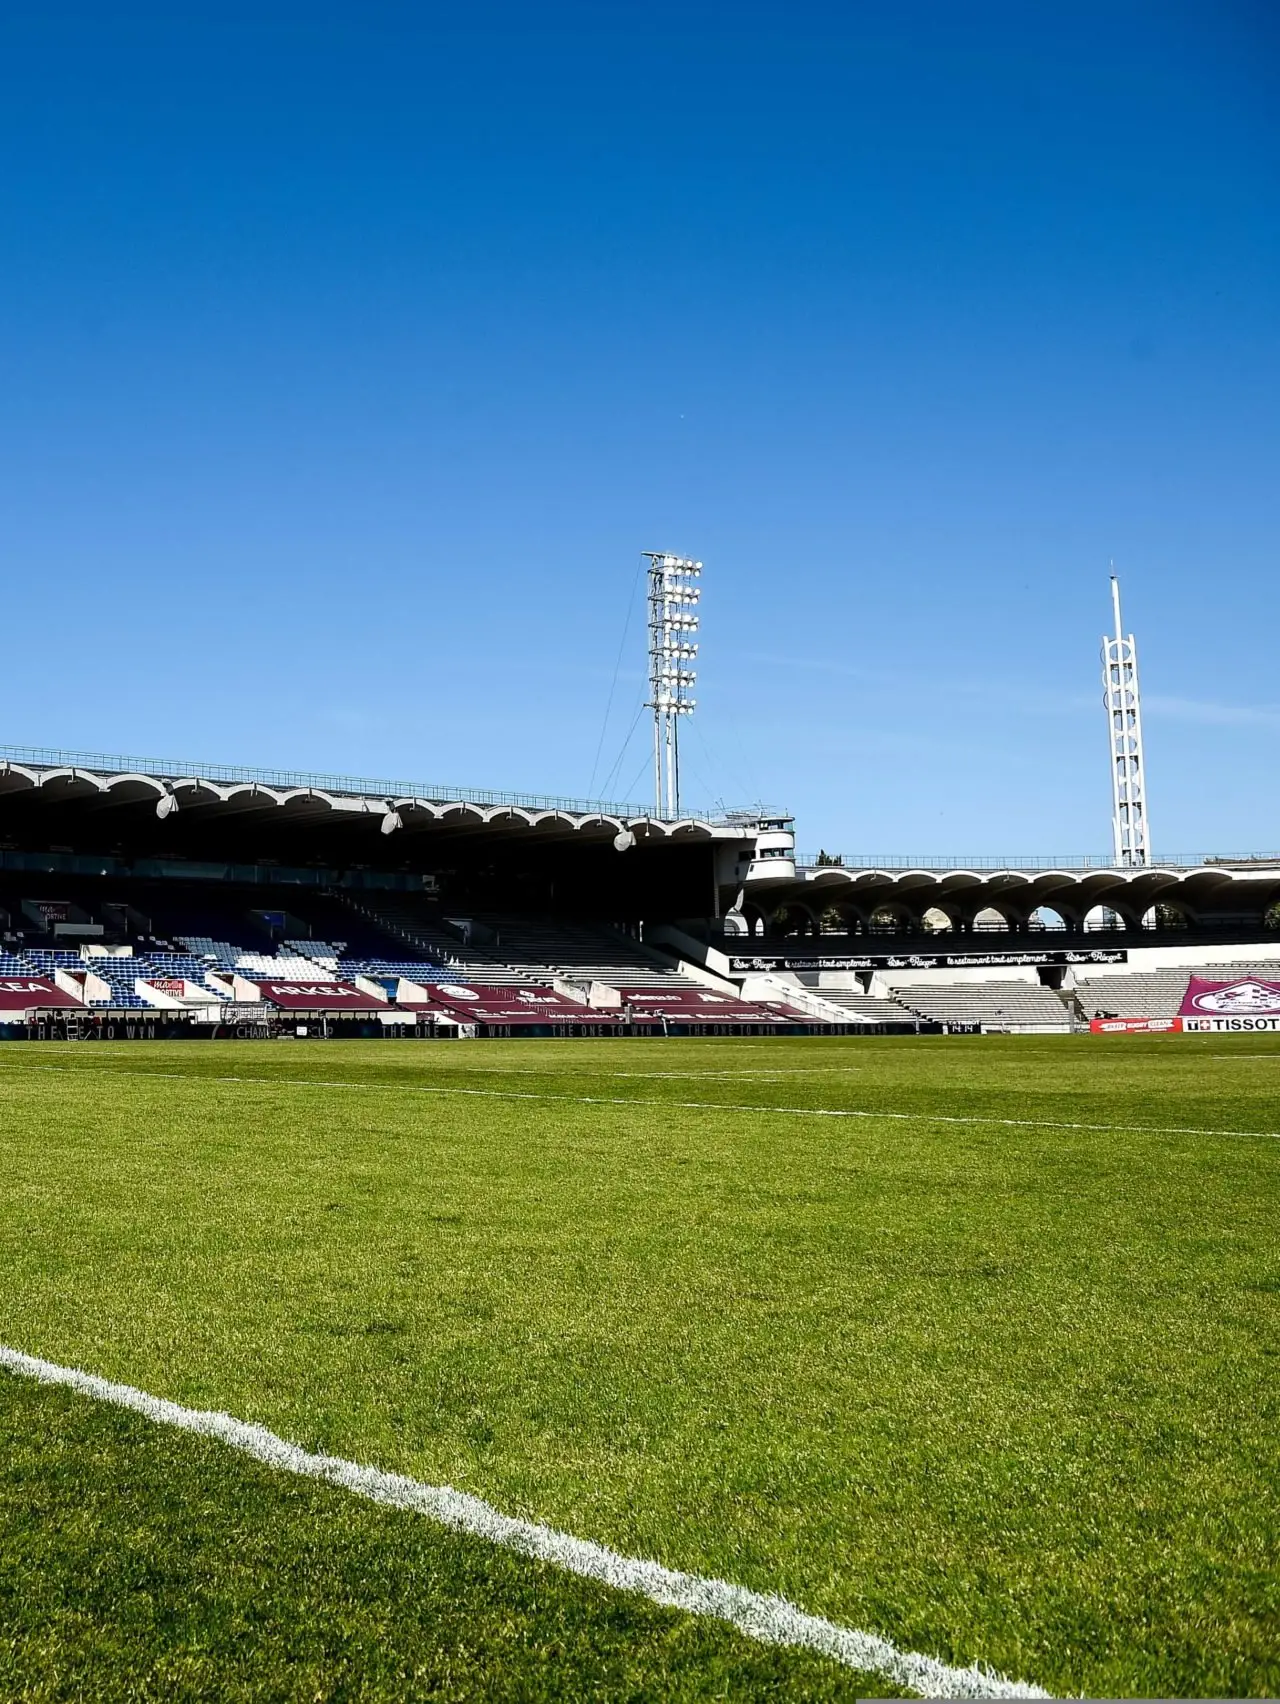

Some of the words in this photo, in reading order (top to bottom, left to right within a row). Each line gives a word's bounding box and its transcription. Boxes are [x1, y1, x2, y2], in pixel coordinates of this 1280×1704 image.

[271, 986, 362, 996] ARKEA
[552, 1025, 574, 1037] THE
[581, 1025, 603, 1036] ONE
[611, 1025, 624, 1036] TO
[1213, 1019, 1280, 1031] TISSOT
[26, 1026, 58, 1040] THE
[382, 1026, 406, 1037] THE
[415, 1026, 439, 1037] ONE
